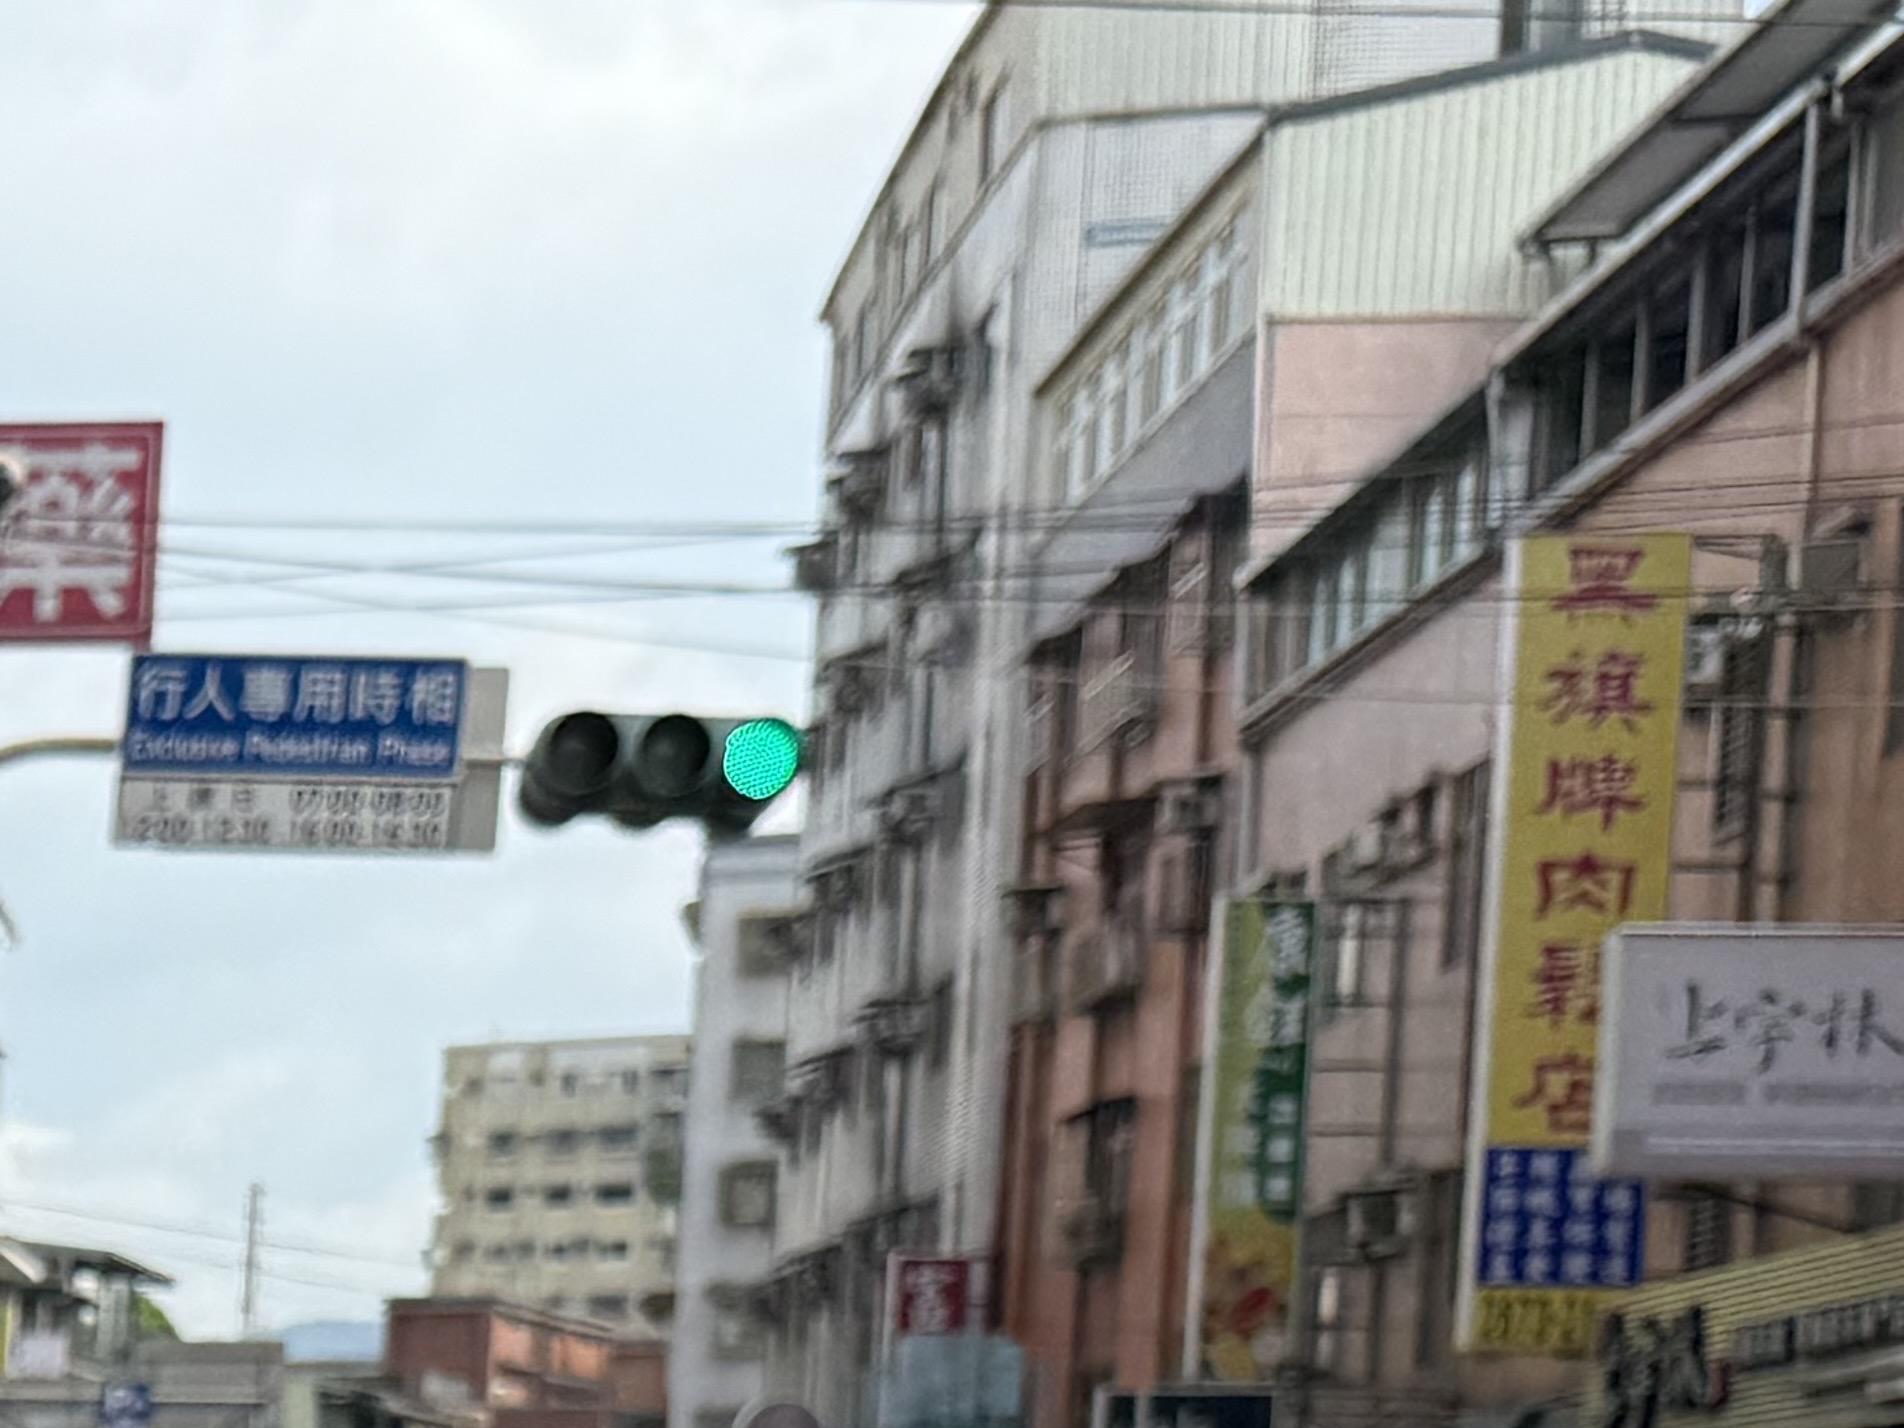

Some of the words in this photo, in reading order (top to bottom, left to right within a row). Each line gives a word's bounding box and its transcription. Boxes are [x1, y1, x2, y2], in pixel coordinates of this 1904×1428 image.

[136, 662, 458, 726] 行人專用時相
[129, 731, 239, 762] Exclusive
[244, 729, 370, 765] Pedestrian
[378, 733, 451, 765] Phase
